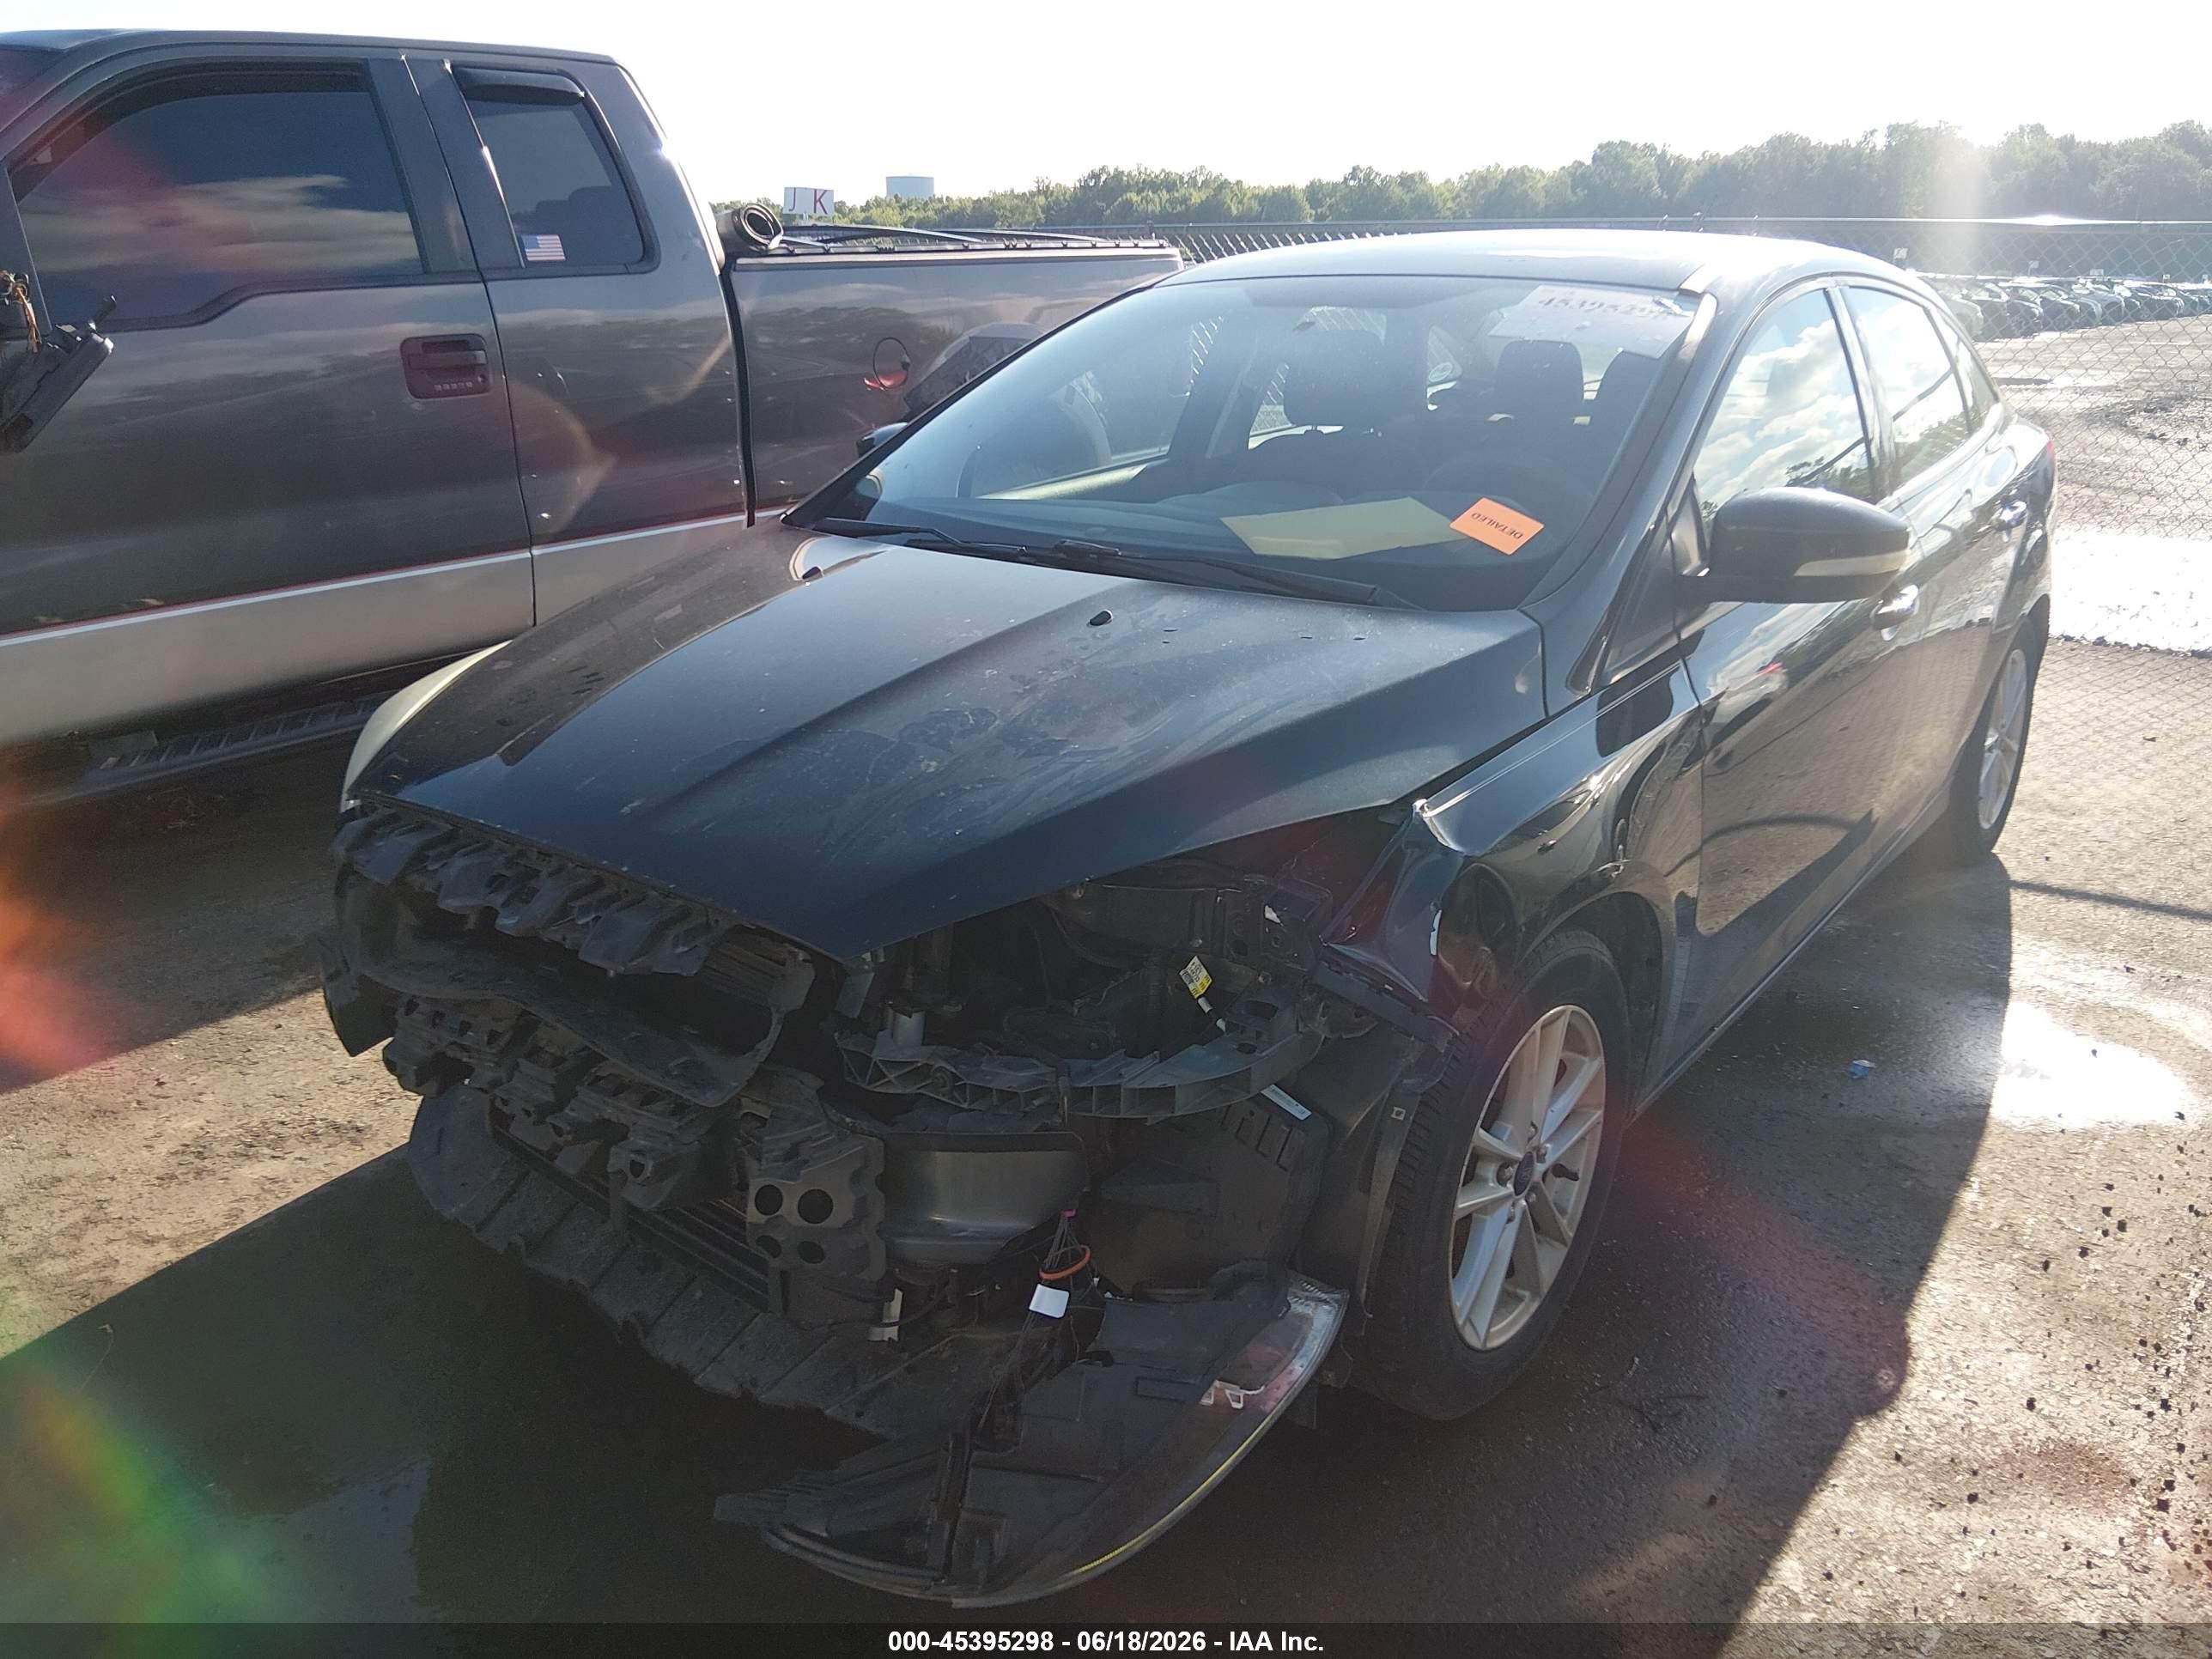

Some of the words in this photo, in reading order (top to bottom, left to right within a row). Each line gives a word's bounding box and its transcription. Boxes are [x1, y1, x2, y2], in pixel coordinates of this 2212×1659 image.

[788, 187, 796, 212] J
[813, 188, 828, 215] K
[1471, 512, 1524, 539] DETAILED
